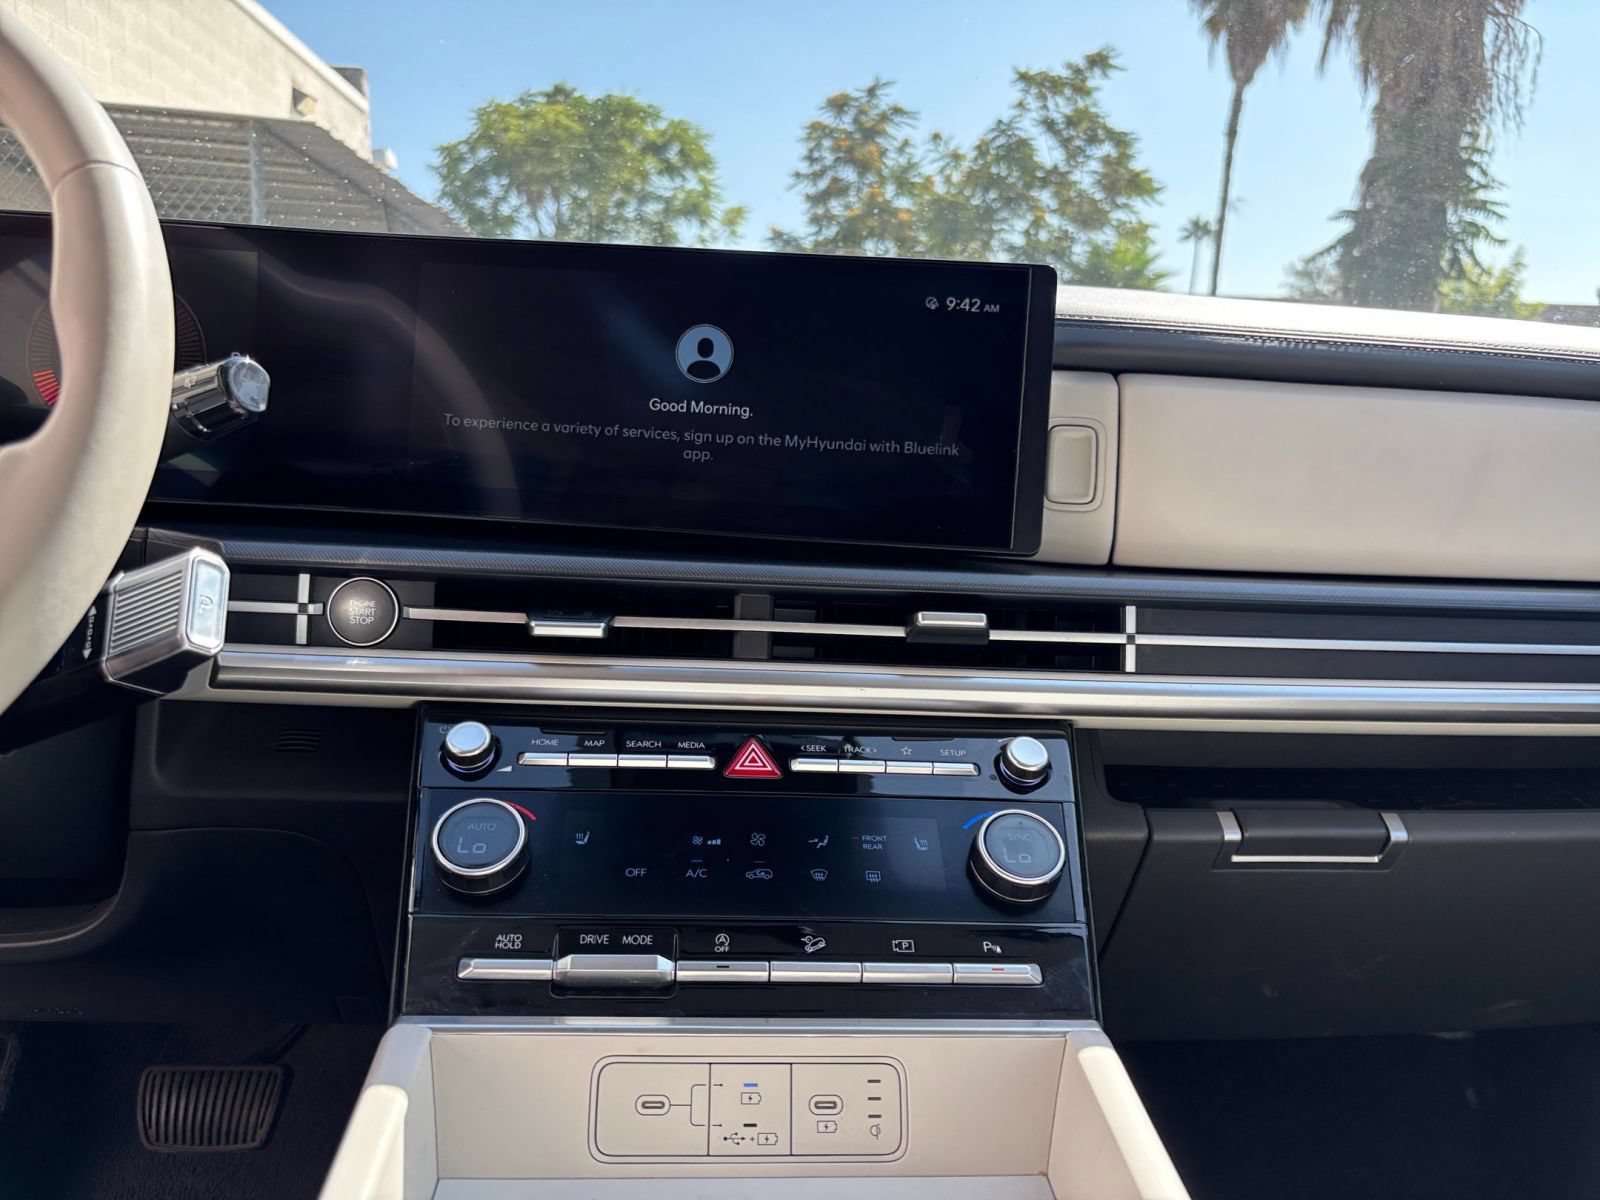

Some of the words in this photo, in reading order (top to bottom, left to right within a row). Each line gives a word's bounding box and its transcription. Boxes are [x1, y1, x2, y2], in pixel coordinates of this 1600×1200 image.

[946, 297, 981, 313] 9:42
[984, 304, 1000, 313] AM
[649, 398, 687, 413] Good
[690, 401, 753, 420] Morning.
[444, 413, 461, 427] To
[463, 416, 538, 432] experience
[541, 422, 551, 432] a
[553, 422, 602, 438] variety
[605, 425, 620, 437] of
[622, 427, 680, 443] services,
[684, 430, 711, 446] sign
[716, 434, 735, 446] up
[737, 436, 755, 445] on
[758, 434, 782, 447] the
[785, 435, 867, 452] MyHyundai
[870, 440, 900, 453] with
[904, 441, 960, 456] Bluelink
[683, 450, 714, 463] app.
[348, 608, 376, 616] START
[349, 616, 375, 625] STOP
[531, 738, 560, 747] HOME
[584, 739, 606, 748] MAP
[625, 740, 662, 749] SEARCH
[677, 741, 706, 750] MEDIA
[939, 748, 967, 757] SETUP
[466, 822, 496, 831] AUTO
[861, 834, 888, 842] FRONT
[1007, 832, 1032, 842] SYNC
[862, 843, 884, 851] REAR
[625, 867, 647, 877] OFF
[685, 868, 708, 878] A/C
[496, 933, 523, 941] AUTO
[579, 934, 610, 945] DRIVE
[621, 934, 653, 945] MODE
[494, 940, 522, 950] HOLD
[714, 945, 730, 953] OFF
